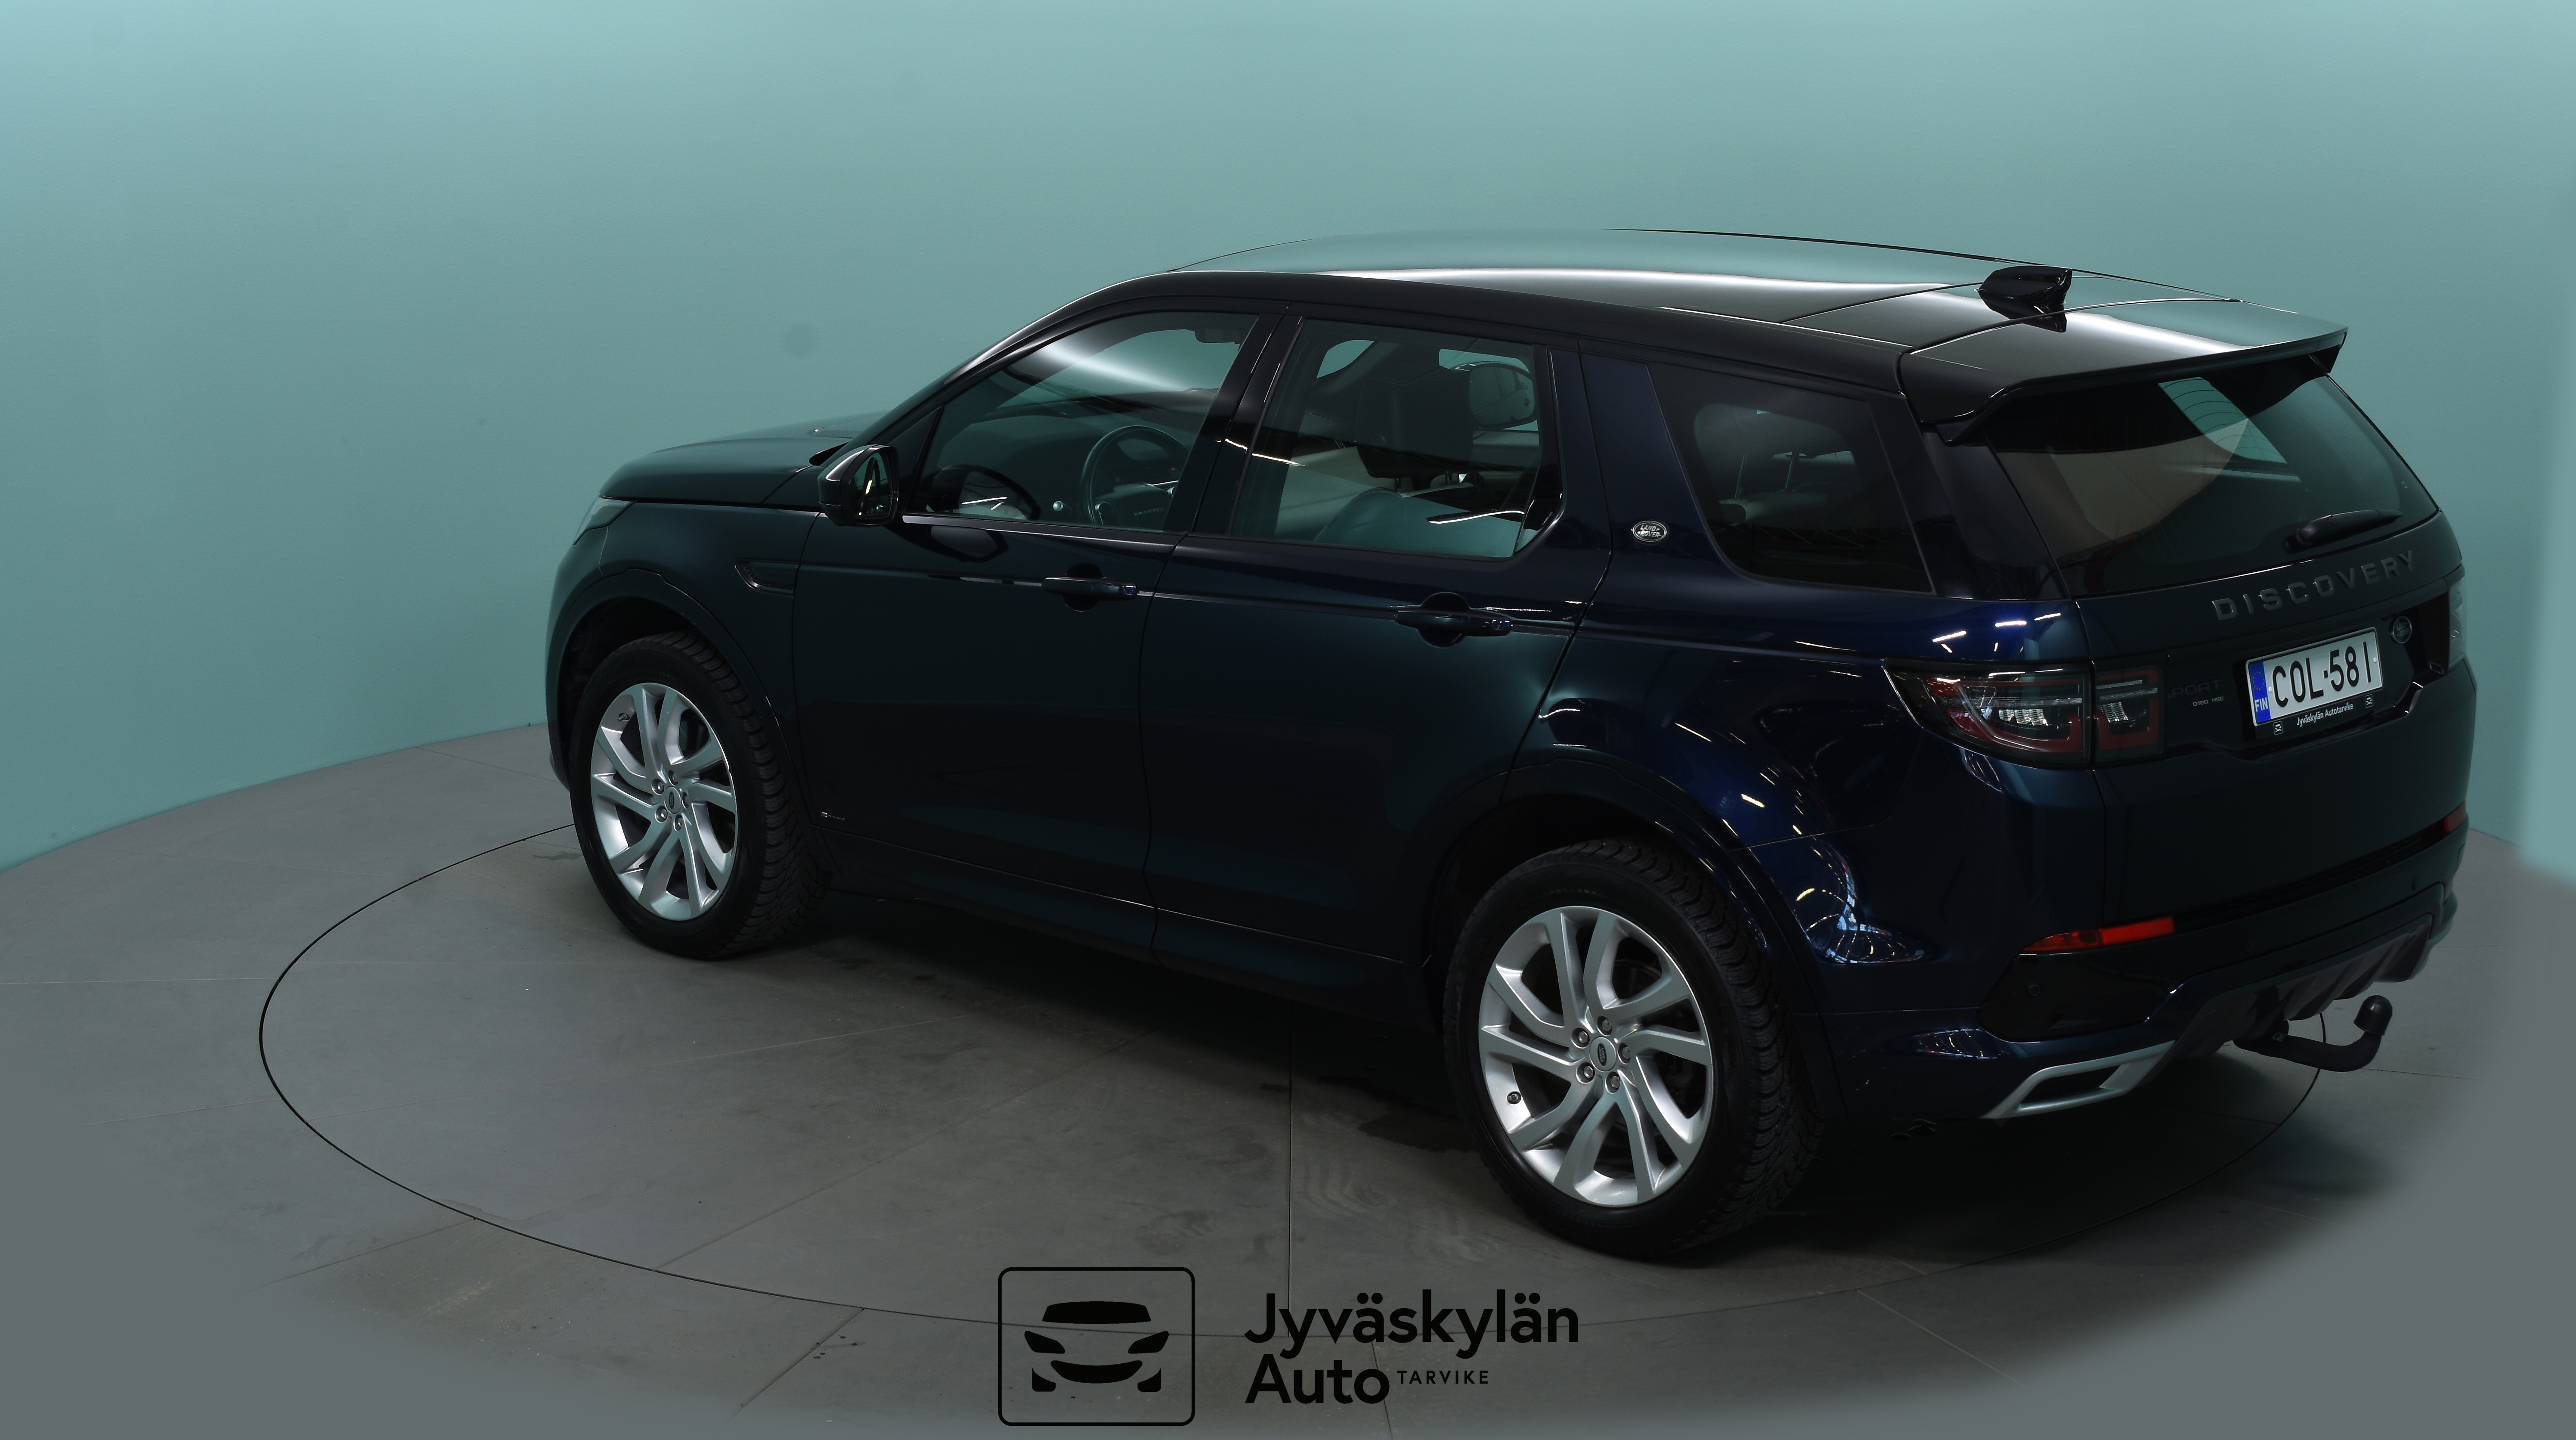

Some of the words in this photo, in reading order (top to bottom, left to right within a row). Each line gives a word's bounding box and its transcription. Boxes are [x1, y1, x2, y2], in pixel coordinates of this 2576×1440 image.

[2212, 551, 2413, 620] DISCOVERY
[2272, 642, 2372, 707] COL-581
[2254, 698, 2269, 713] FIN
[2296, 711, 2324, 727] Jyväskylän
[2325, 702, 2353, 717] Autotarvike
